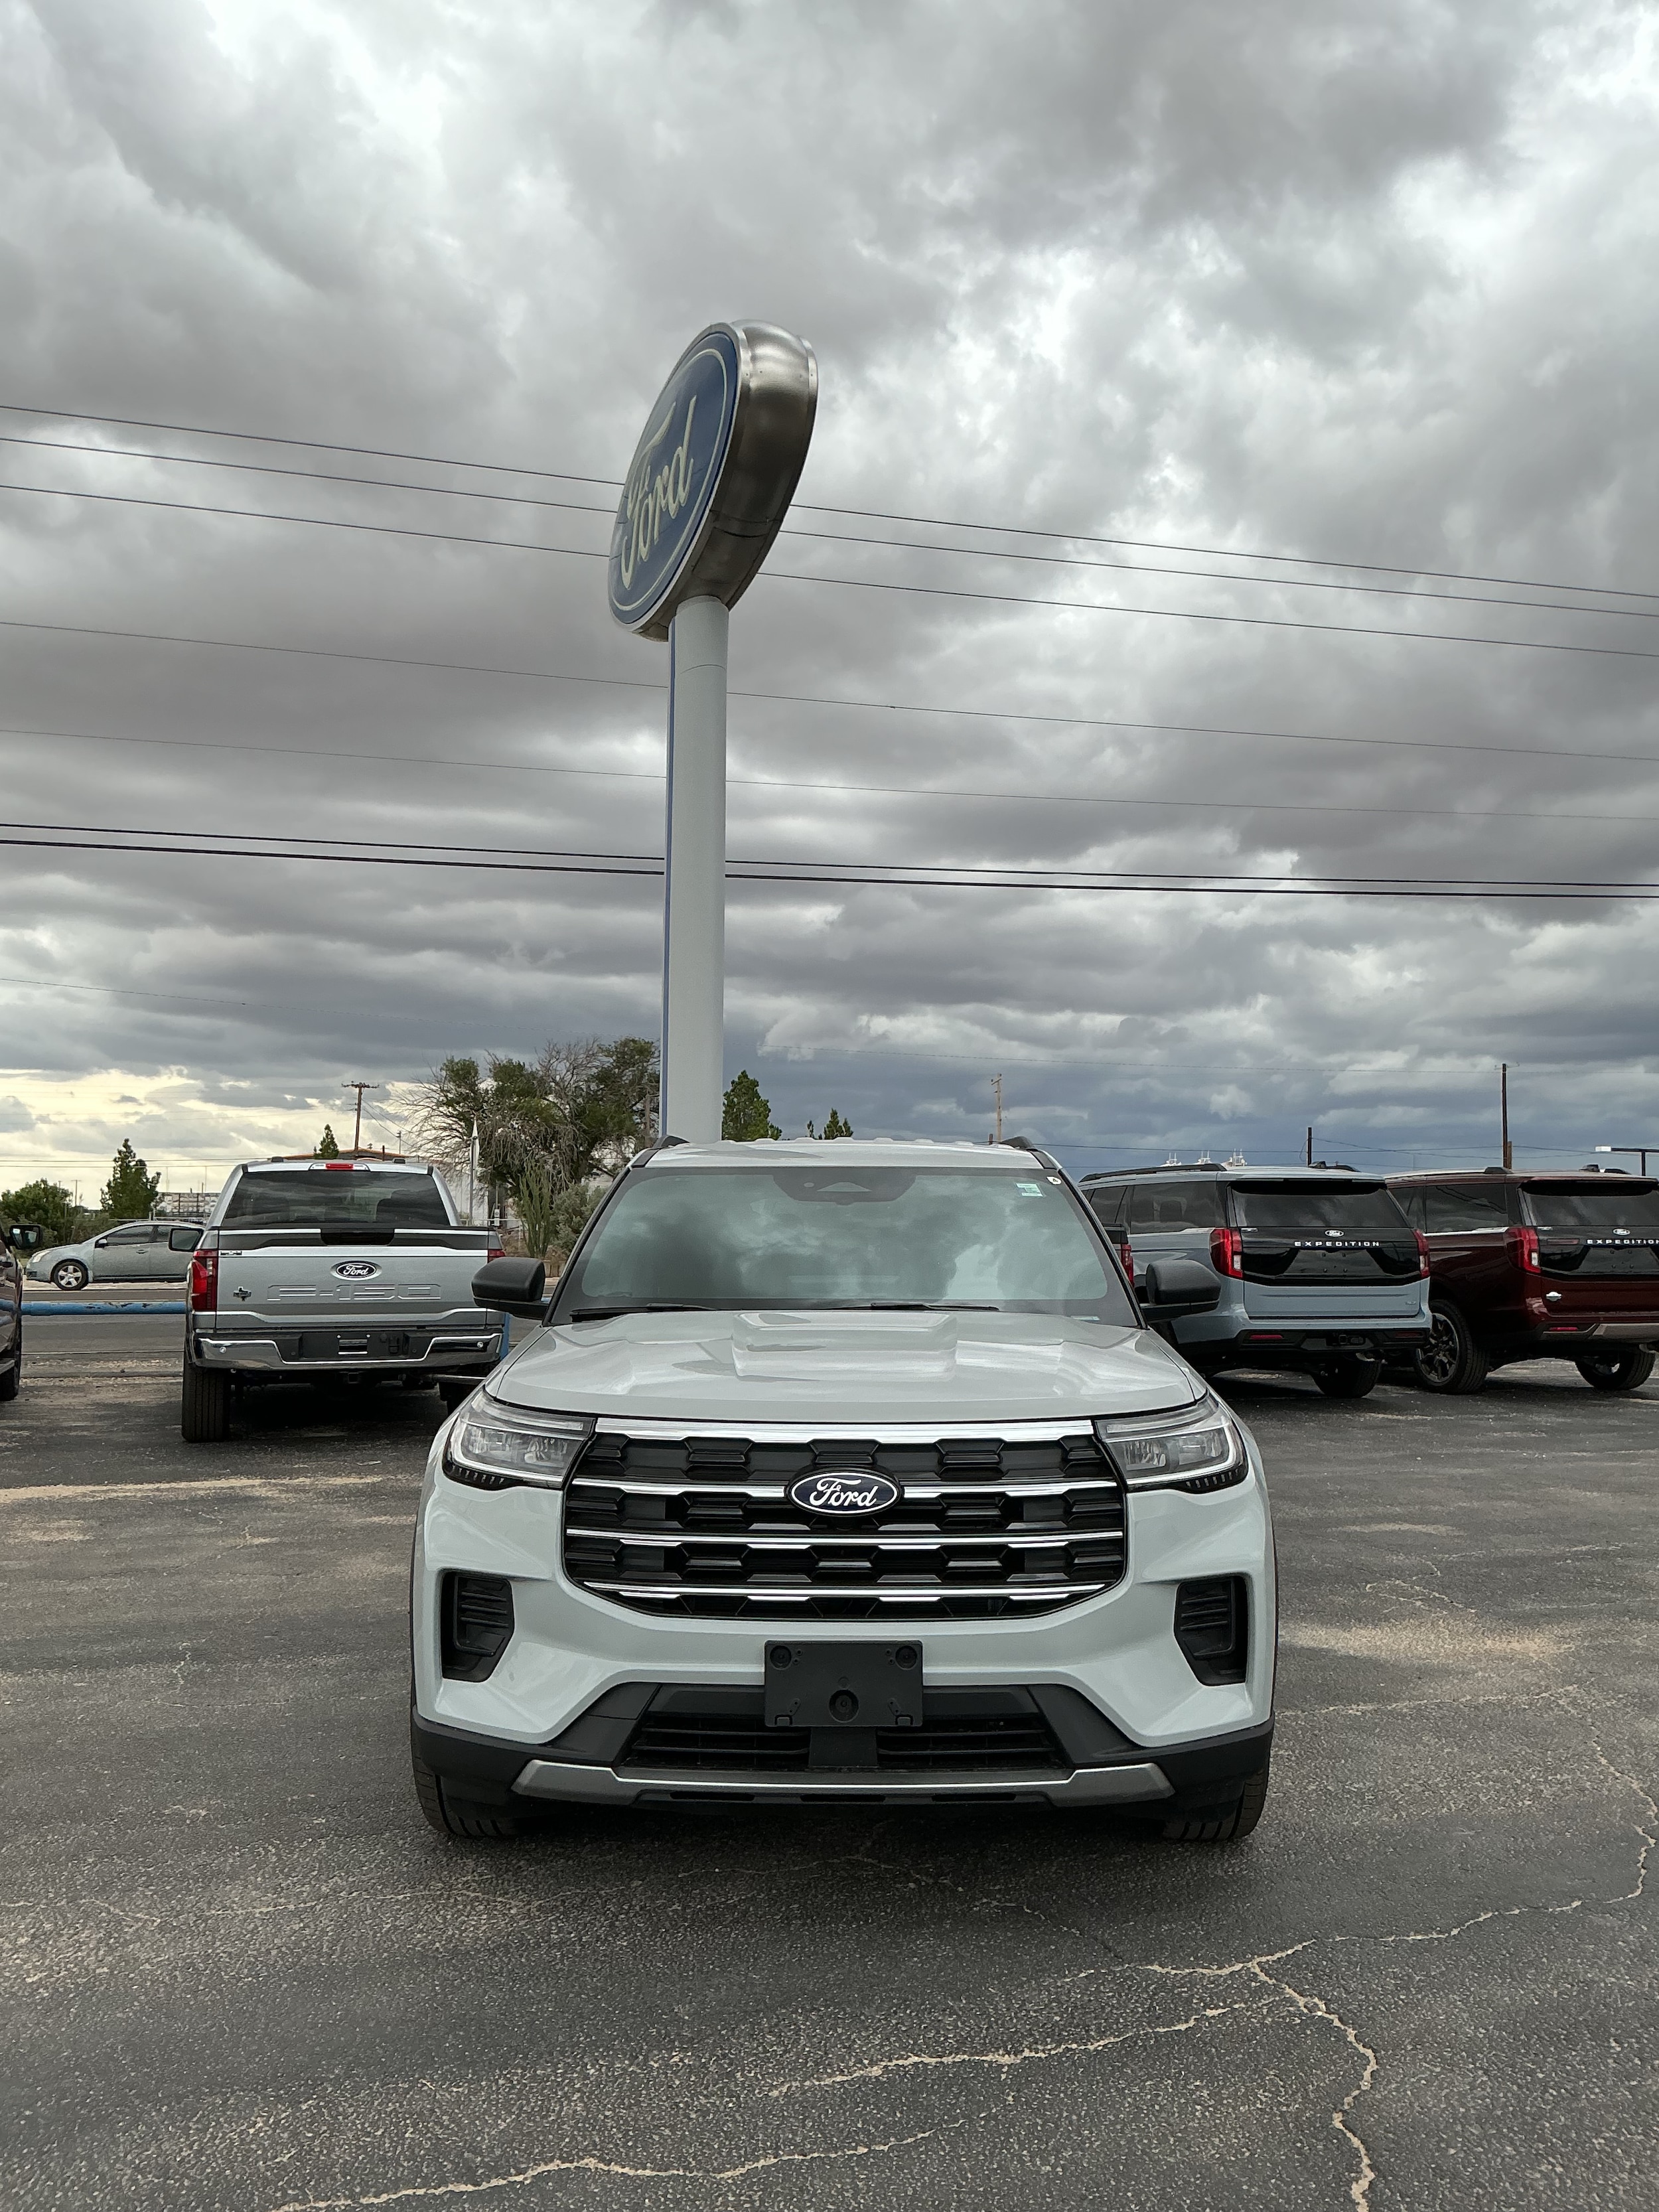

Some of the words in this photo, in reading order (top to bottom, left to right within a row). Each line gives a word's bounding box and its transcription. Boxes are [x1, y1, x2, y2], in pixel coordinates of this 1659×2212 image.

[620, 395, 697, 590] Ford
[342, 1264, 370, 1276] Ford
[267, 1284, 441, 1301] F-150
[809, 1477, 879, 1507] Ford
